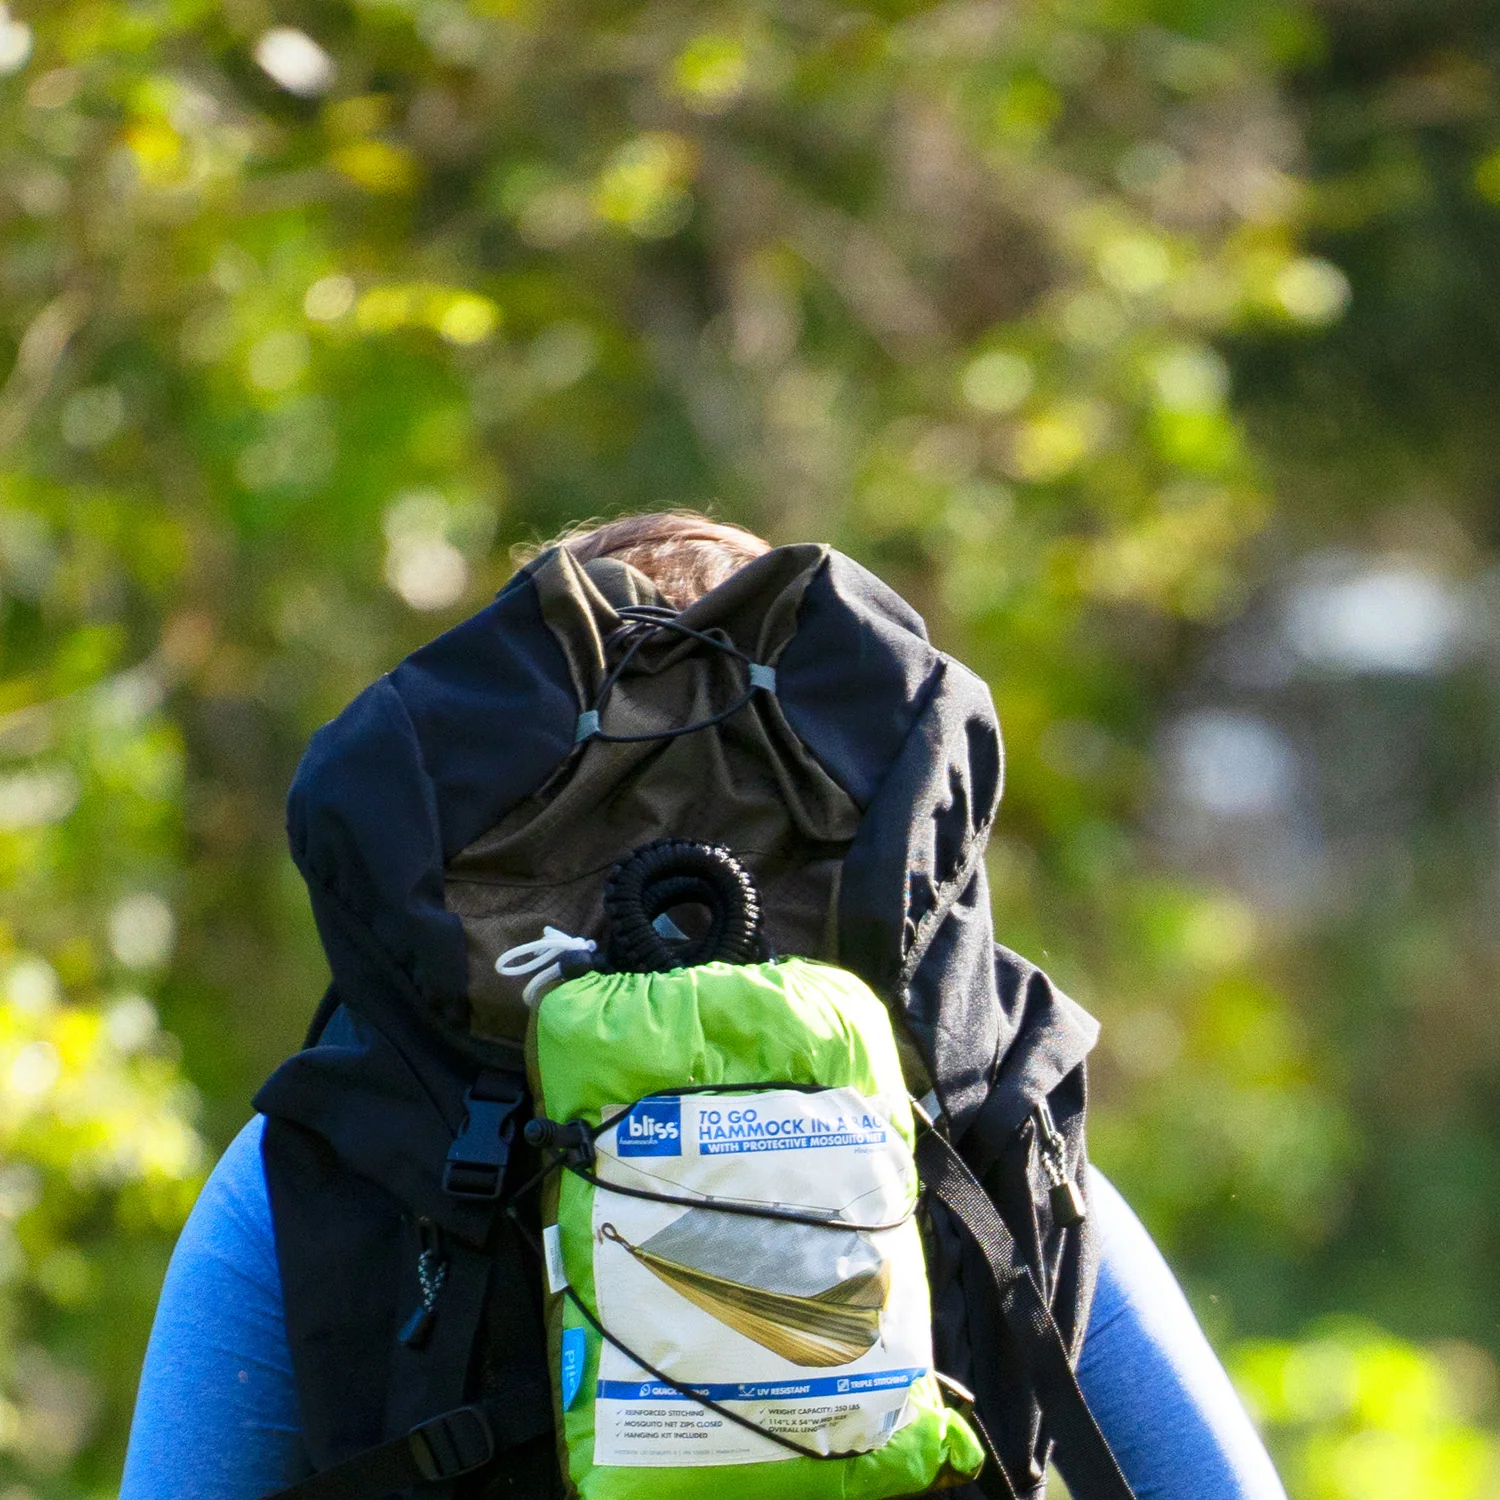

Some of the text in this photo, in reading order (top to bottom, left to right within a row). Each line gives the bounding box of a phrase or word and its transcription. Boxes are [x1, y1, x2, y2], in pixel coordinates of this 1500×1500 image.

[699, 1108, 758, 1125] TO GO
[628, 1114, 679, 1140] bliss
[699, 1118, 805, 1141] HAMMOCK
[810, 1117, 831, 1133] IN
[836, 1115, 849, 1132] A
[708, 1143, 739, 1154] WITH
[743, 1137, 807, 1152] PROTECTIVE
[810, 1132, 864, 1147] MOSQUITO
[851, 1379, 873, 1389] TRIPLE
[757, 1385, 811, 1396] UV RESISTANT
[624, 1409, 705, 1417] REINFORCED STITCHING
[624, 1420, 723, 1428] MOSQUITO NET ZIPS CLOSED
[768, 1426, 799, 1434] OVERALL
